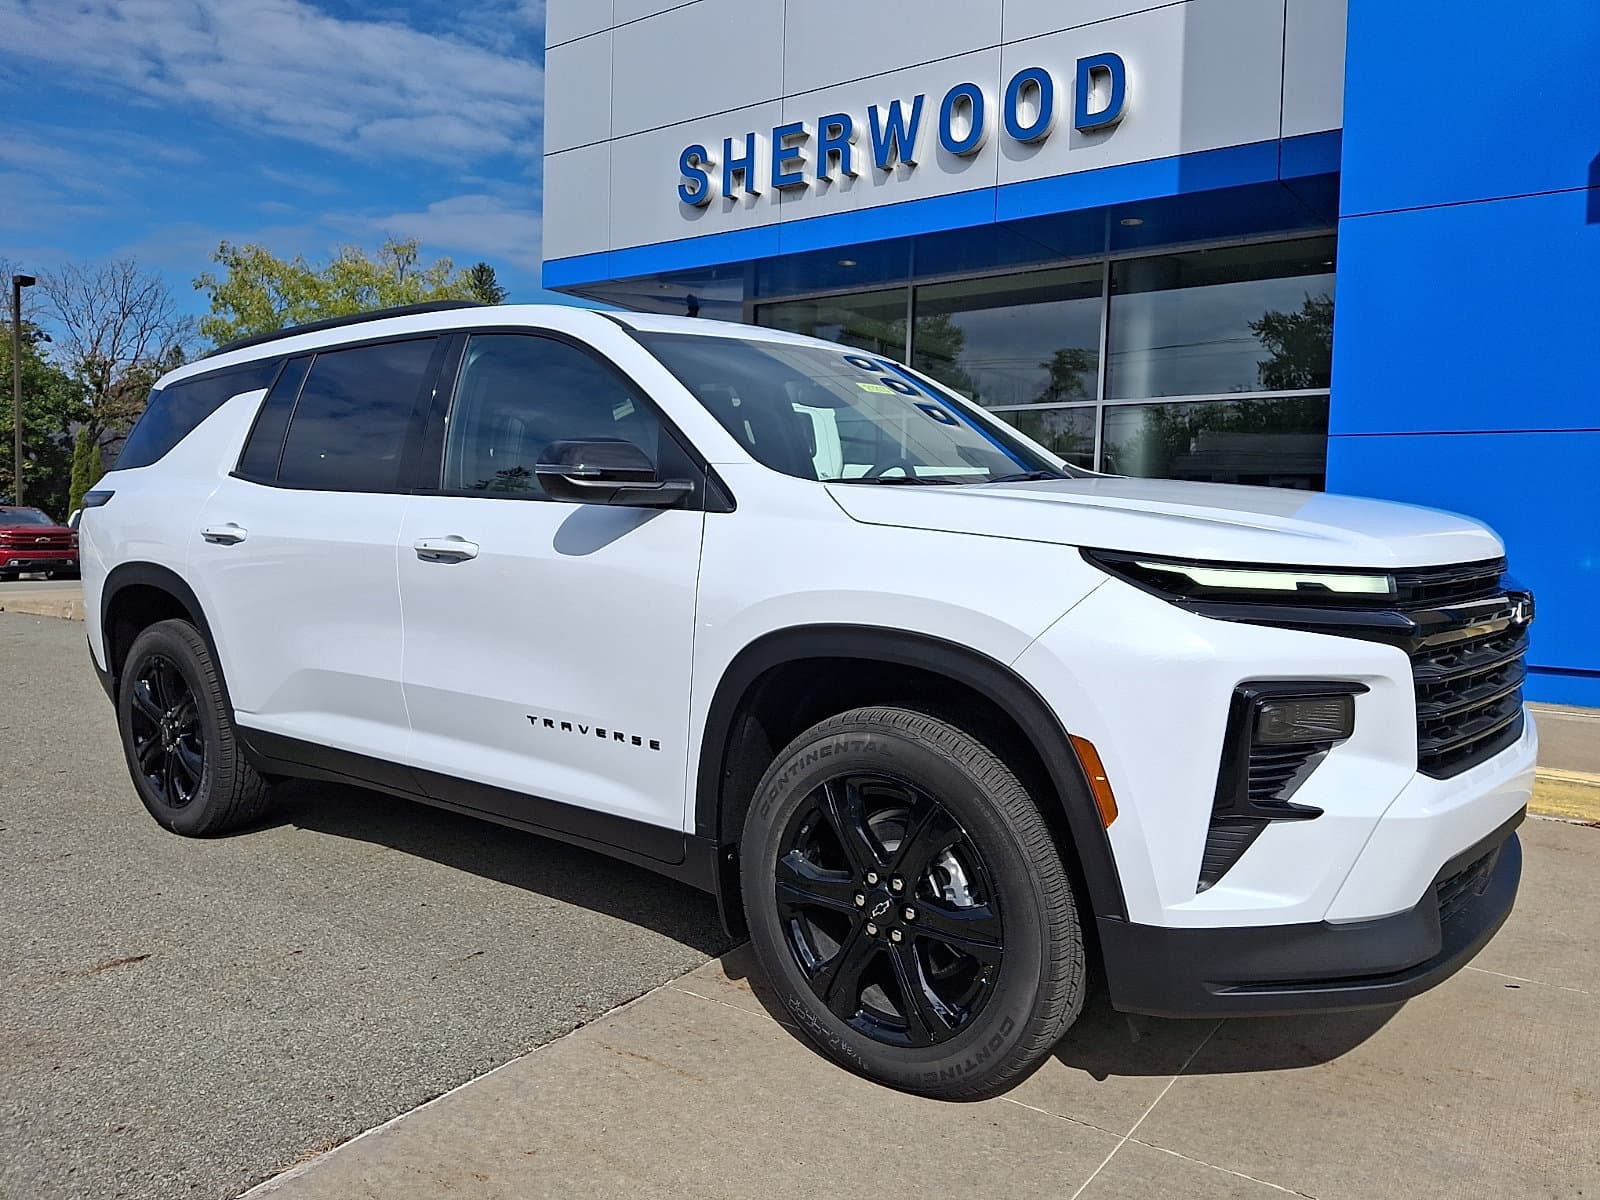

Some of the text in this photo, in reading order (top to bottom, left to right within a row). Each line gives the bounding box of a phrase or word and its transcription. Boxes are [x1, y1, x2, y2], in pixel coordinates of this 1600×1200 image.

[677, 51, 1128, 206] SHERWOOD
[526, 714, 661, 751] TRAVERSE
[900, 1016, 1015, 1083] CONTINE
